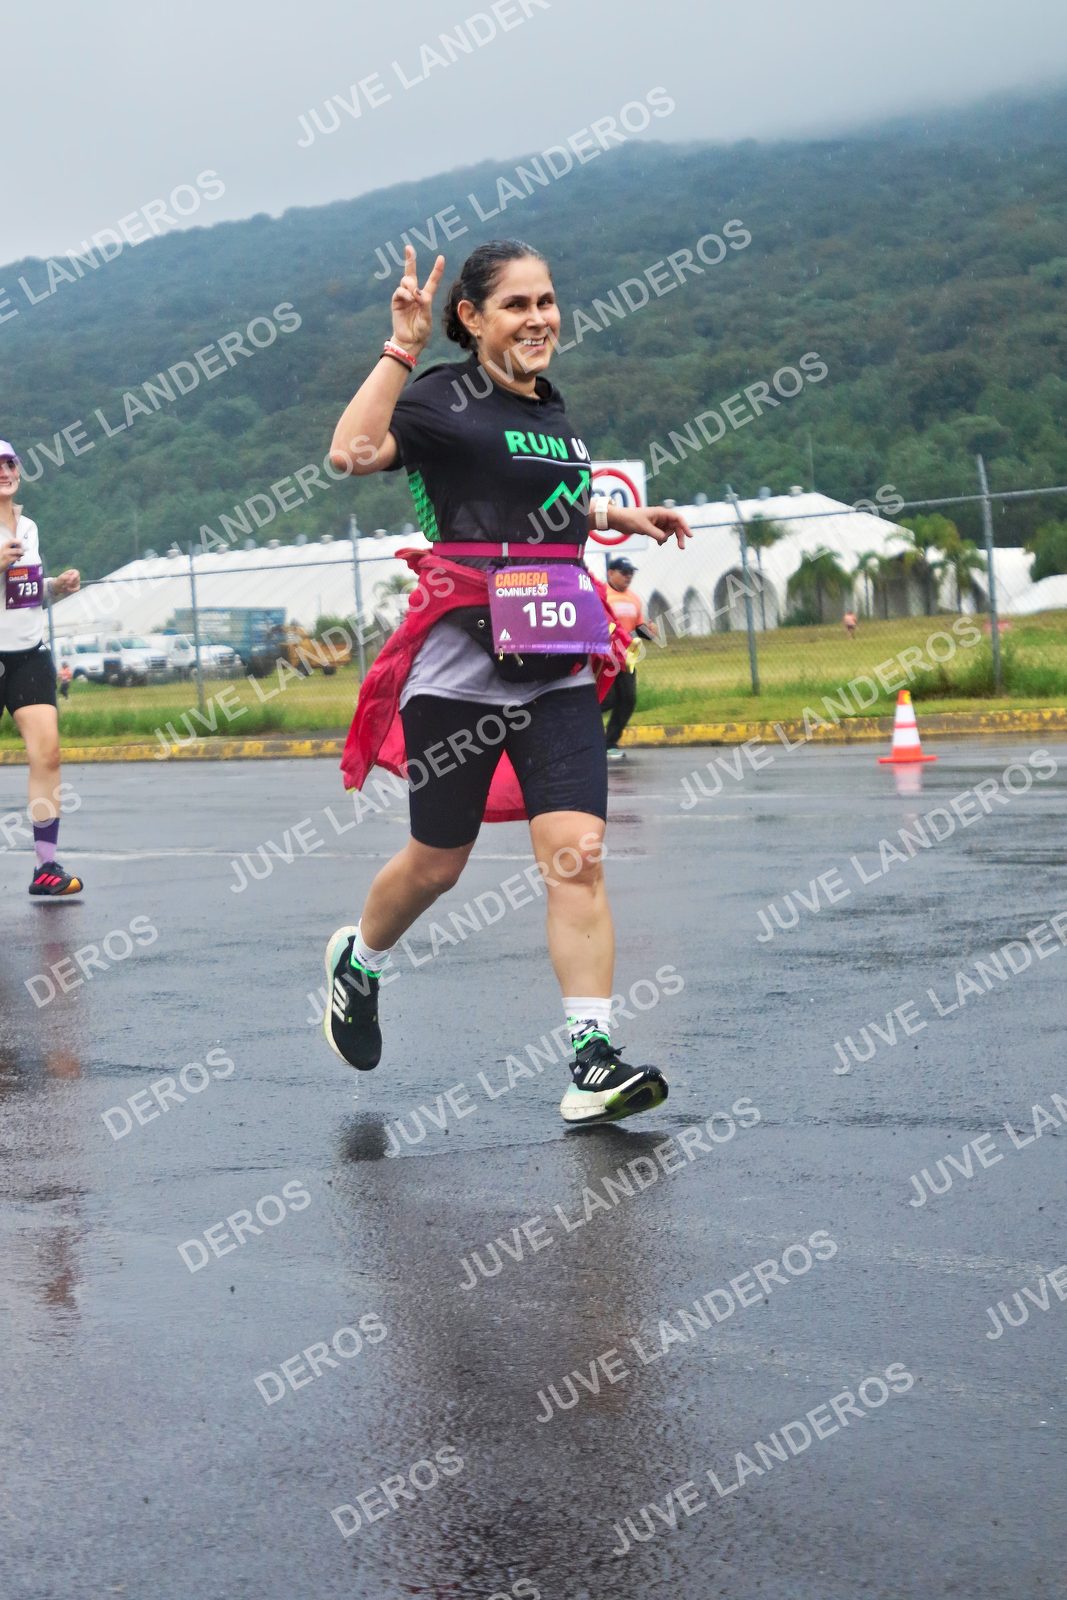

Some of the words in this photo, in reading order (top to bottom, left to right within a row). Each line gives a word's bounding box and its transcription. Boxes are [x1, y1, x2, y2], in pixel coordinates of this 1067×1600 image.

[504, 431, 568, 459] RUN
[571, 437, 591, 461] U
[495, 572, 548, 587] CARRERA
[18, 581, 38, 596] 733
[496, 586, 537, 597] OMNILIFE
[523, 602, 576, 627] 150
